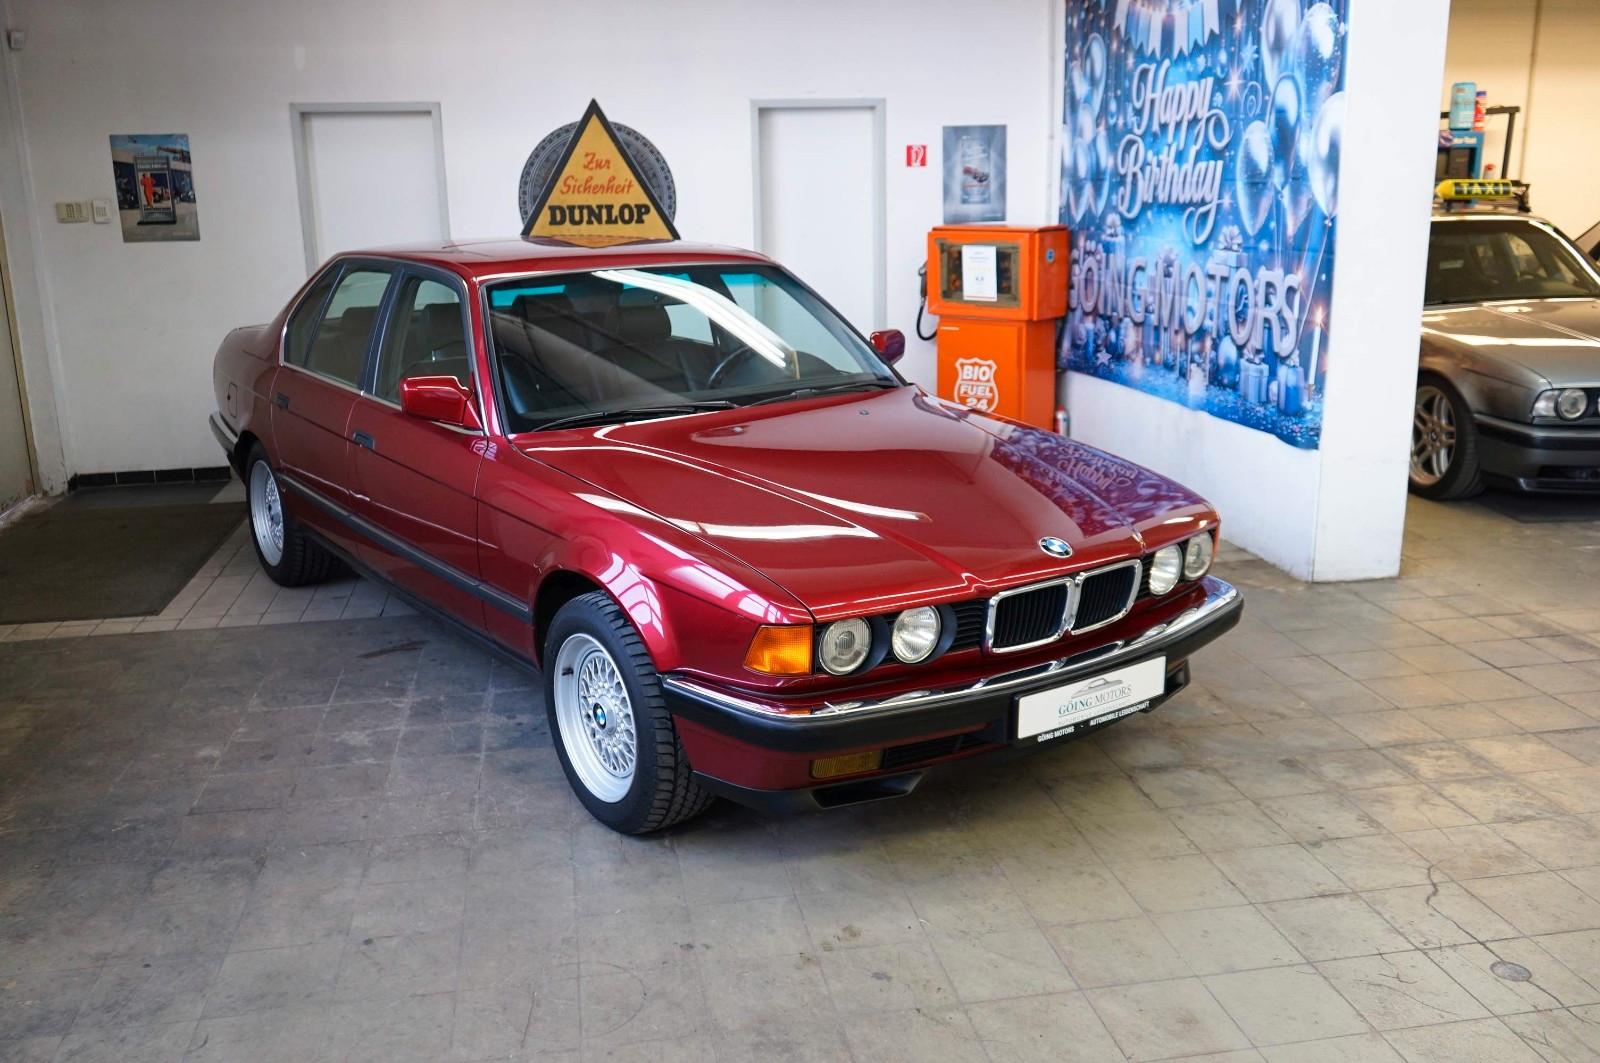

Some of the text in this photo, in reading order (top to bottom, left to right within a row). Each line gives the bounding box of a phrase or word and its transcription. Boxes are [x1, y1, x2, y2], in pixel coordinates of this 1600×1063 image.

[1132, 58, 1231, 150] Happy
[582, 152, 611, 171] Zur
[560, 175, 635, 195] Sicherheit
[1117, 134, 1225, 245] Birthday
[1461, 183, 1504, 195] TAXI
[548, 203, 651, 226] DUNLOP
[1154, 256, 1300, 358] MOTORS
[962, 365, 991, 381] BIO
[960, 384, 993, 398] FUEL
[966, 397, 989, 411] 24
[1058, 698, 1093, 715] GÖING
[1095, 684, 1133, 704] MOTORS
[1054, 725, 1075, 738] MOTORS
[1089, 711, 1119, 726] AUTOMOBILE
